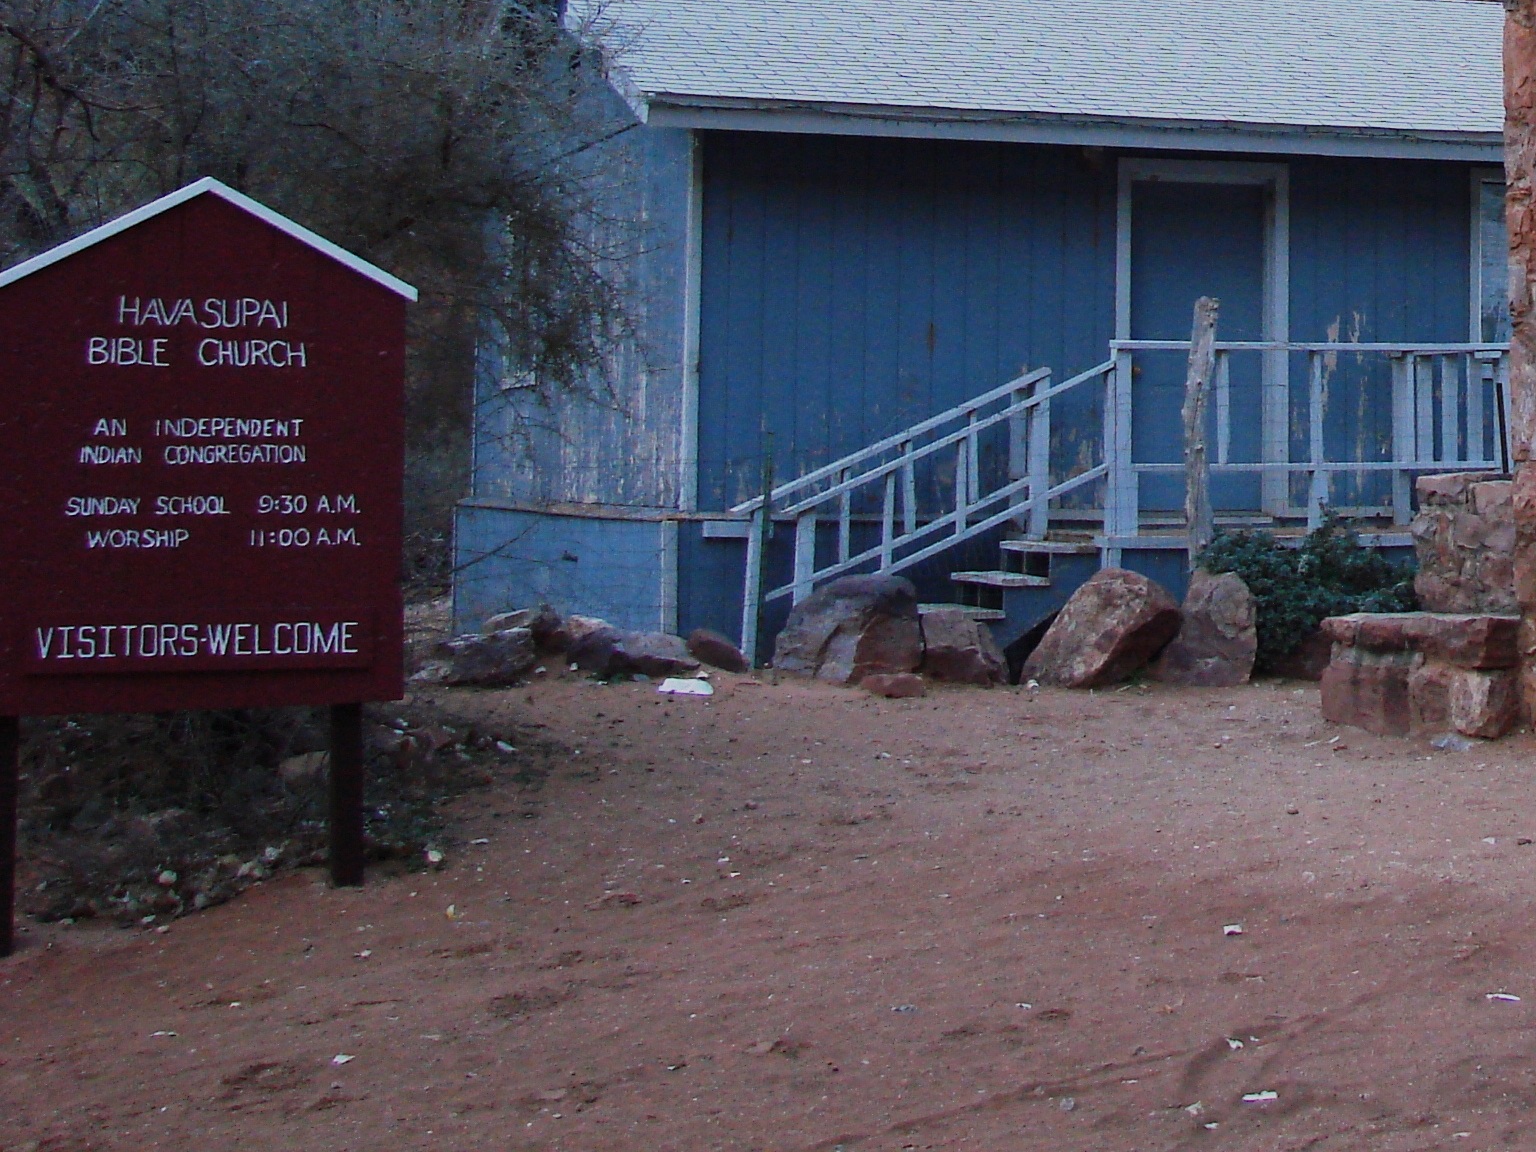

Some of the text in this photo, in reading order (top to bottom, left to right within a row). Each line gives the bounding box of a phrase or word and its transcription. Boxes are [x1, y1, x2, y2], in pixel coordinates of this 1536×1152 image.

[118, 295, 288, 329] HAVASUPAI
[88, 337, 307, 368] BIBLE CHURCH
[94, 417, 304, 438] AN INDEPENDENT
[79, 444, 306, 465] INDIAN CONGREGATION
[65, 494, 361, 516] SUNDAY SCHOOL 9:30 A.M.
[87, 527, 361, 548] WORSHIP 11:00 A.M.
